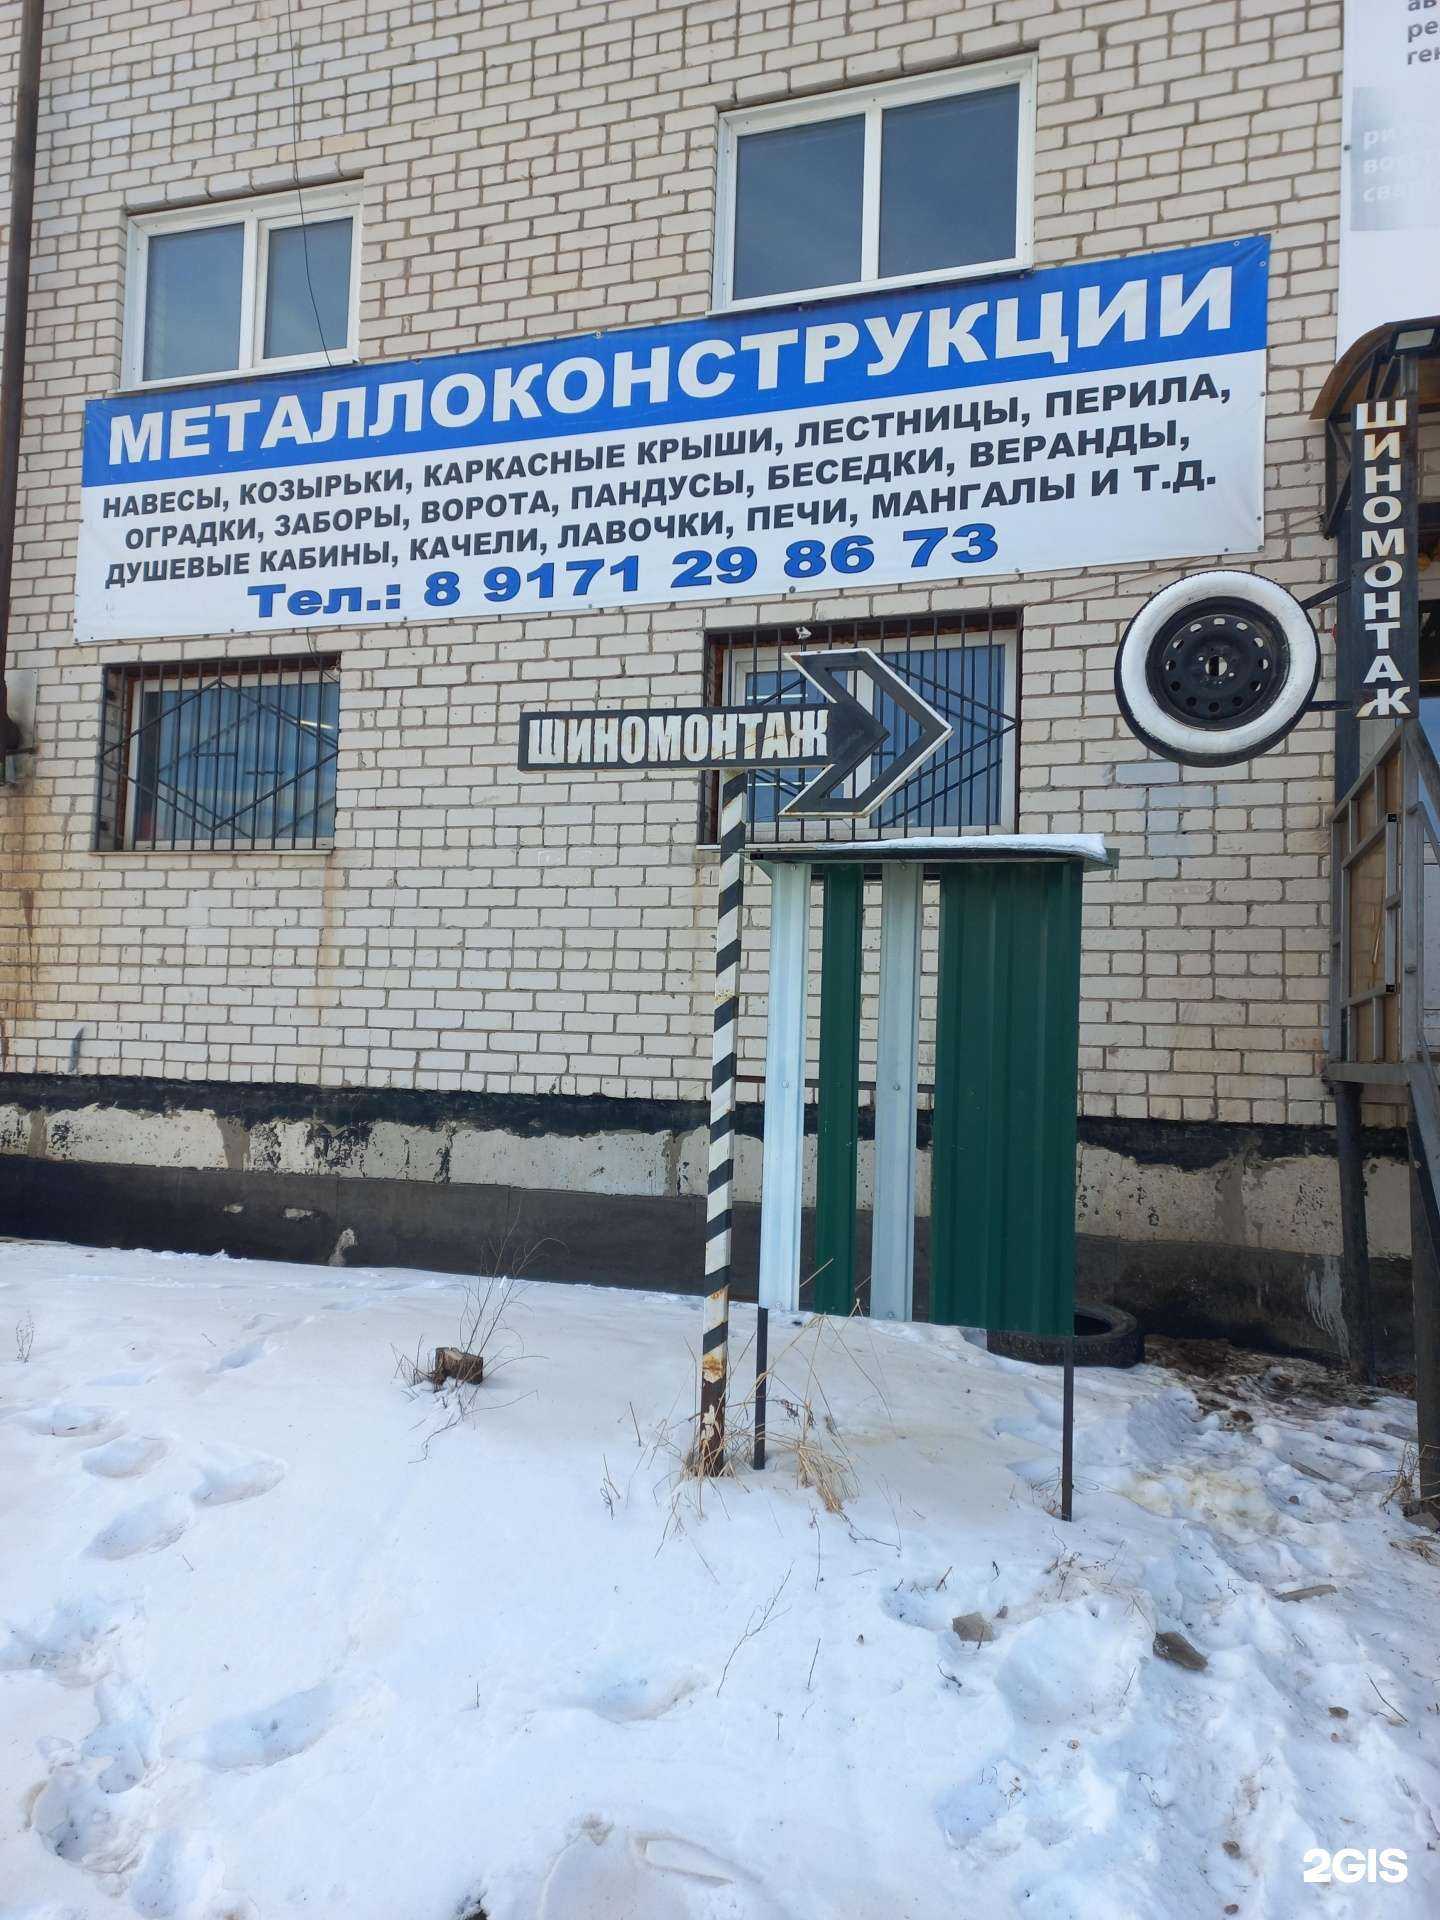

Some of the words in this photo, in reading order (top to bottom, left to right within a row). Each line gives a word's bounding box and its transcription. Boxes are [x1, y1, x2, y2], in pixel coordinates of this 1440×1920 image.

[108, 265, 1233, 466] МЕТАЛЛОКОНСТРУКЦИИ
[102, 486, 230, 519] НАВЕСЫ,
[239, 468, 413, 506] КОЗЫРЬКИ,
[423, 443, 626, 488] КАРКАСНЫЕ
[637, 427, 784, 465] КРЫШИ,
[794, 396, 1031, 448] ЛЕСТНИЦЫ,
[1045, 373, 1231, 418] ПЕРИЛА,
[125, 517, 265, 550] ОГРАДКИ,
[274, 504, 410, 537] ЗАБОРЫ,
[421, 489, 559, 524] ВОРОТА,
[571, 469, 755, 508] ПАНДУСЫ,
[767, 446, 956, 490] БЕСЕДКИ,
[969, 420, 1190, 468] ВЕРАНДЫ,
[104, 552, 251, 590] ДУШЕВЫЕ
[260, 541, 399, 573] КАБИНЫ,
[409, 527, 548, 561] КАЧЕЛИ,
[557, 510, 734, 549] ЛАВОЧКИ,
[747, 497, 859, 532] ПЕЧИ,
[871, 472, 1076, 519] МАНГАЛЫ
[1090, 468, 1119, 497] И
[1133, 459, 1217, 494] Т.Д.
[246, 582, 401, 619] Тел.:
[423, 570, 461, 607] 8
[482, 554, 640, 602] 9171
[669, 545, 759, 589] 29
[783, 534, 875, 579] 86
[902, 522, 999, 567] 73
[1356, 399, 1411, 717] ШИНОМОНТАЖ
[527, 709, 829, 765] ШИНОМОНТАЖ
